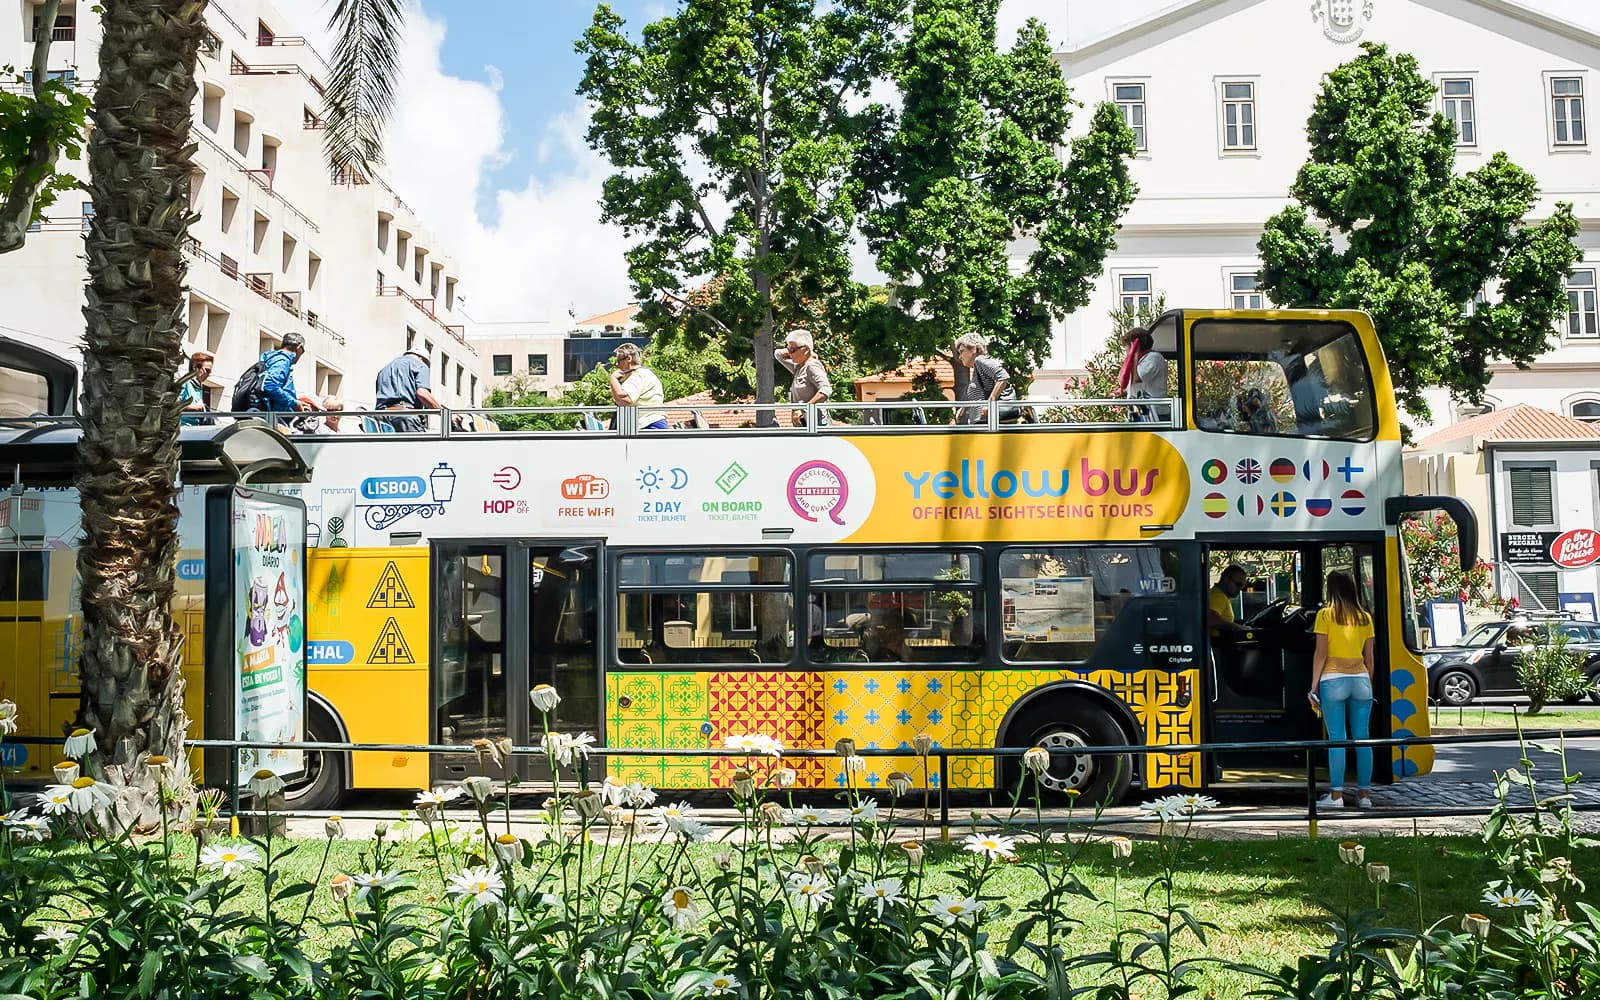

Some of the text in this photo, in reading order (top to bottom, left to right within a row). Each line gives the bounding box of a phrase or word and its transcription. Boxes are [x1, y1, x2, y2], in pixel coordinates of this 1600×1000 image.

[797, 469, 838, 486] EXCELLENCE
[903, 457, 1159, 499] yellow bus
[367, 480, 419, 495] LISBOA
[483, 500, 515, 514] HOP
[558, 507, 614, 516] FREE WI-FI
[643, 502, 681, 513] 2 DAY
[702, 501, 762, 512] ON BOARD
[797, 497, 837, 512] AND QUALITY
[912, 504, 1153, 520] OFFICIAL SIGHTSEEING TOURS
[1560, 532, 1595, 555] food
[1573, 531, 1589, 543] the
[1559, 547, 1595, 562] house
[1149, 644, 1193, 653] CAMO
